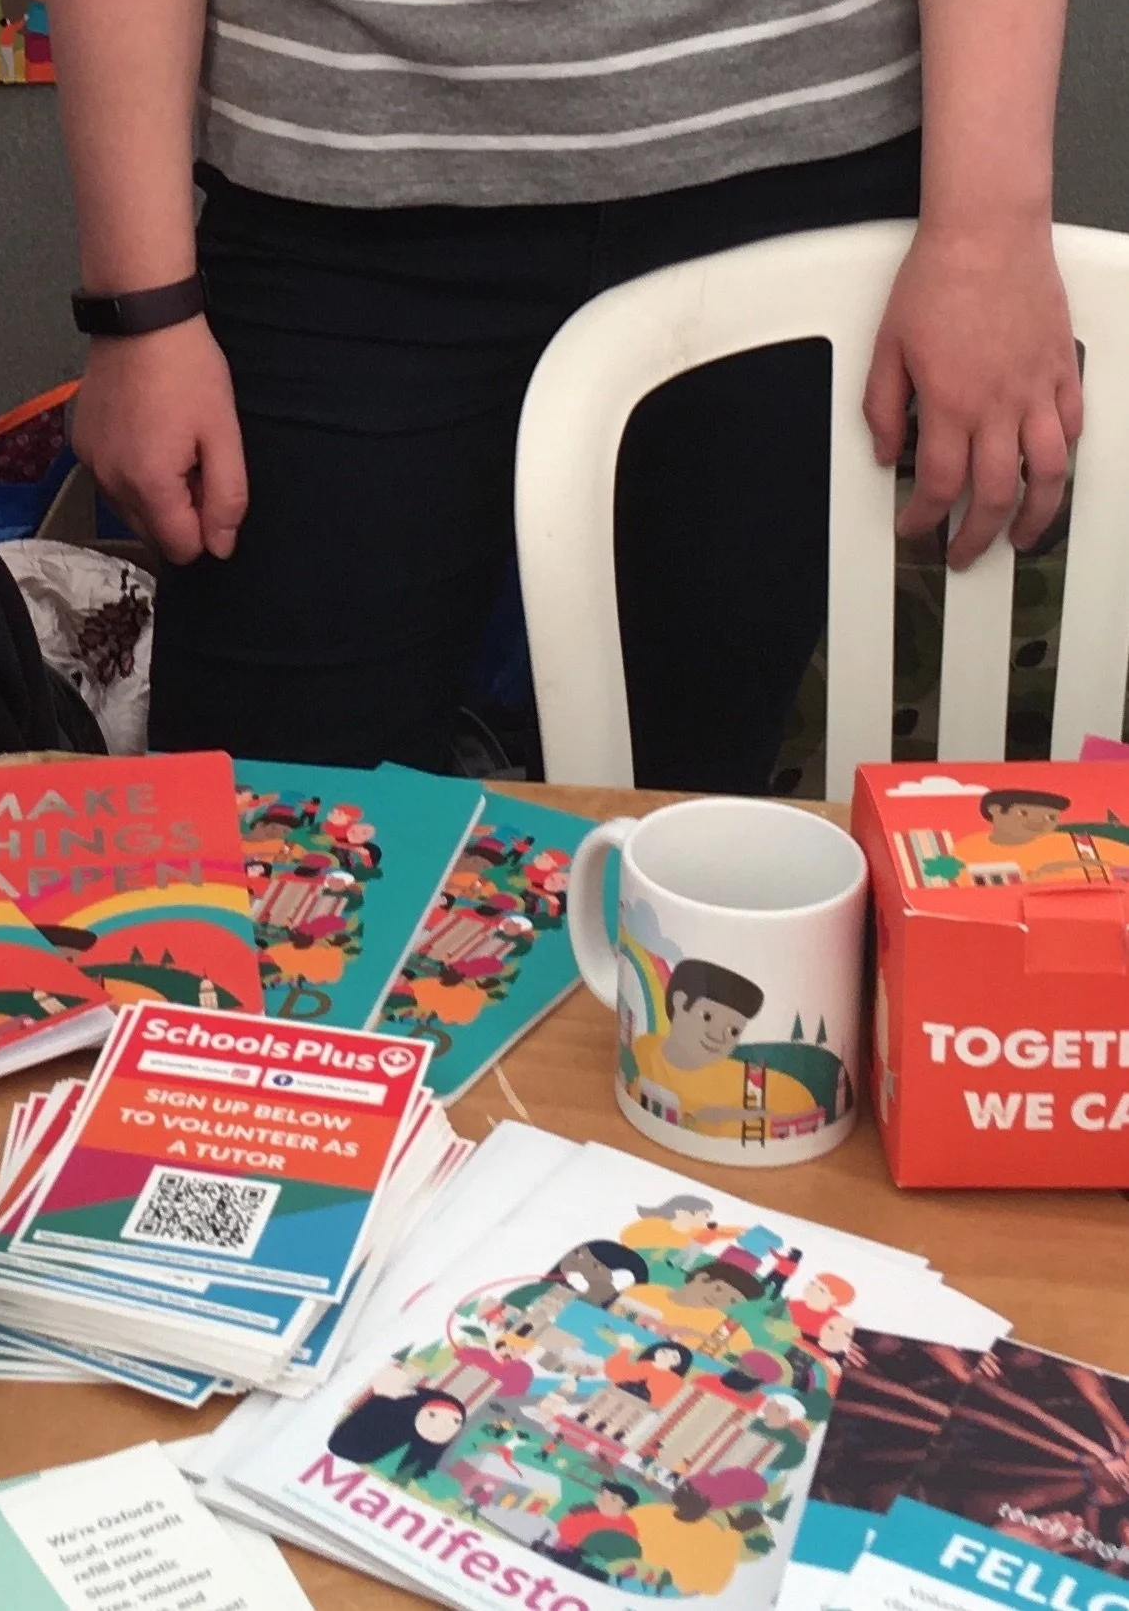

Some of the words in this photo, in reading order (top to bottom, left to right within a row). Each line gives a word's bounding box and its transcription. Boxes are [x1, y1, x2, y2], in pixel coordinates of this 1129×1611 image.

[144, 1087, 208, 1111] SIGN
[212, 1097, 250, 1117] UP
[253, 1103, 352, 1132] BELOW
[964, 1091, 1054, 1130] WE
[120, 1107, 156, 1127] TO
[162, 1114, 319, 1152] VOLUNTEER
[321, 1139, 360, 1159] AS
[167, 1139, 188, 1157] A
[194, 1142, 286, 1172] TUTOR
[97, 1500, 165, 1529] Oxford's
[104, 1513, 183, 1550] non-profit
